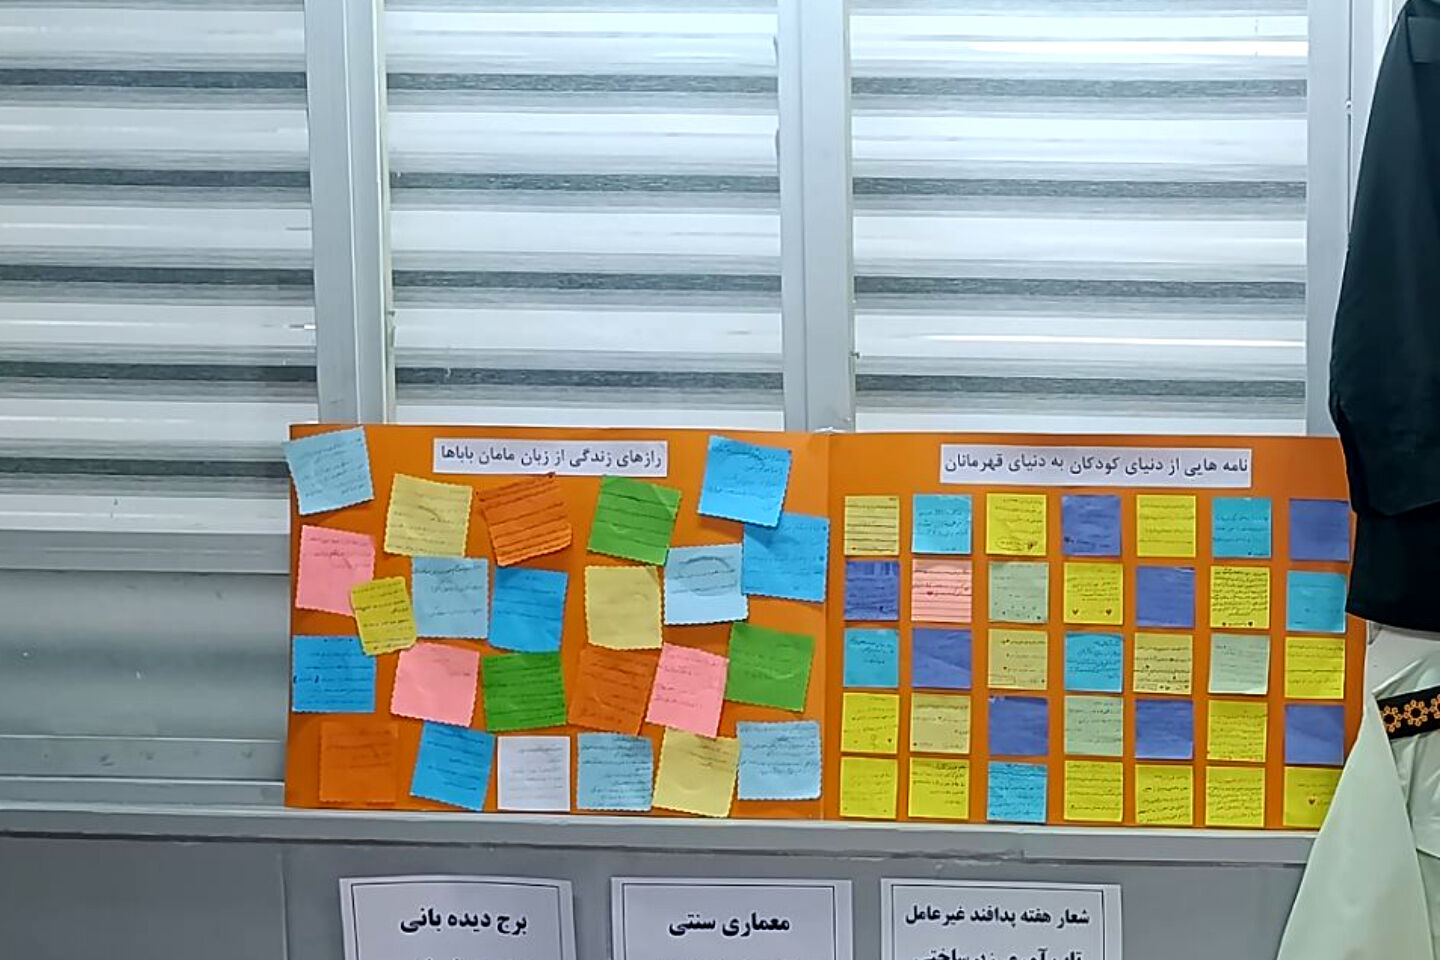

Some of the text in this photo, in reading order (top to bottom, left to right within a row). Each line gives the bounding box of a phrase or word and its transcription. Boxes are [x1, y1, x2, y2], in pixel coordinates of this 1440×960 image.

[478, 447, 515, 465] مامان
[521, 447, 549, 466] زبان
[554, 449, 564, 466] از
[570, 448, 611, 467] زندگی
[616, 450, 662, 468] رازهای
[945, 453, 1248, 477] نامه هایی از دنیای کودکان به دنیای قهرمانان
[401, 907, 527, 935] برج دیده بانی
[669, 912, 790, 937] معماری سنتی
[970, 906, 1016, 927] پدافند
[1020, 908, 1051, 924] هفته
[1056, 909, 1090, 929] شعار
